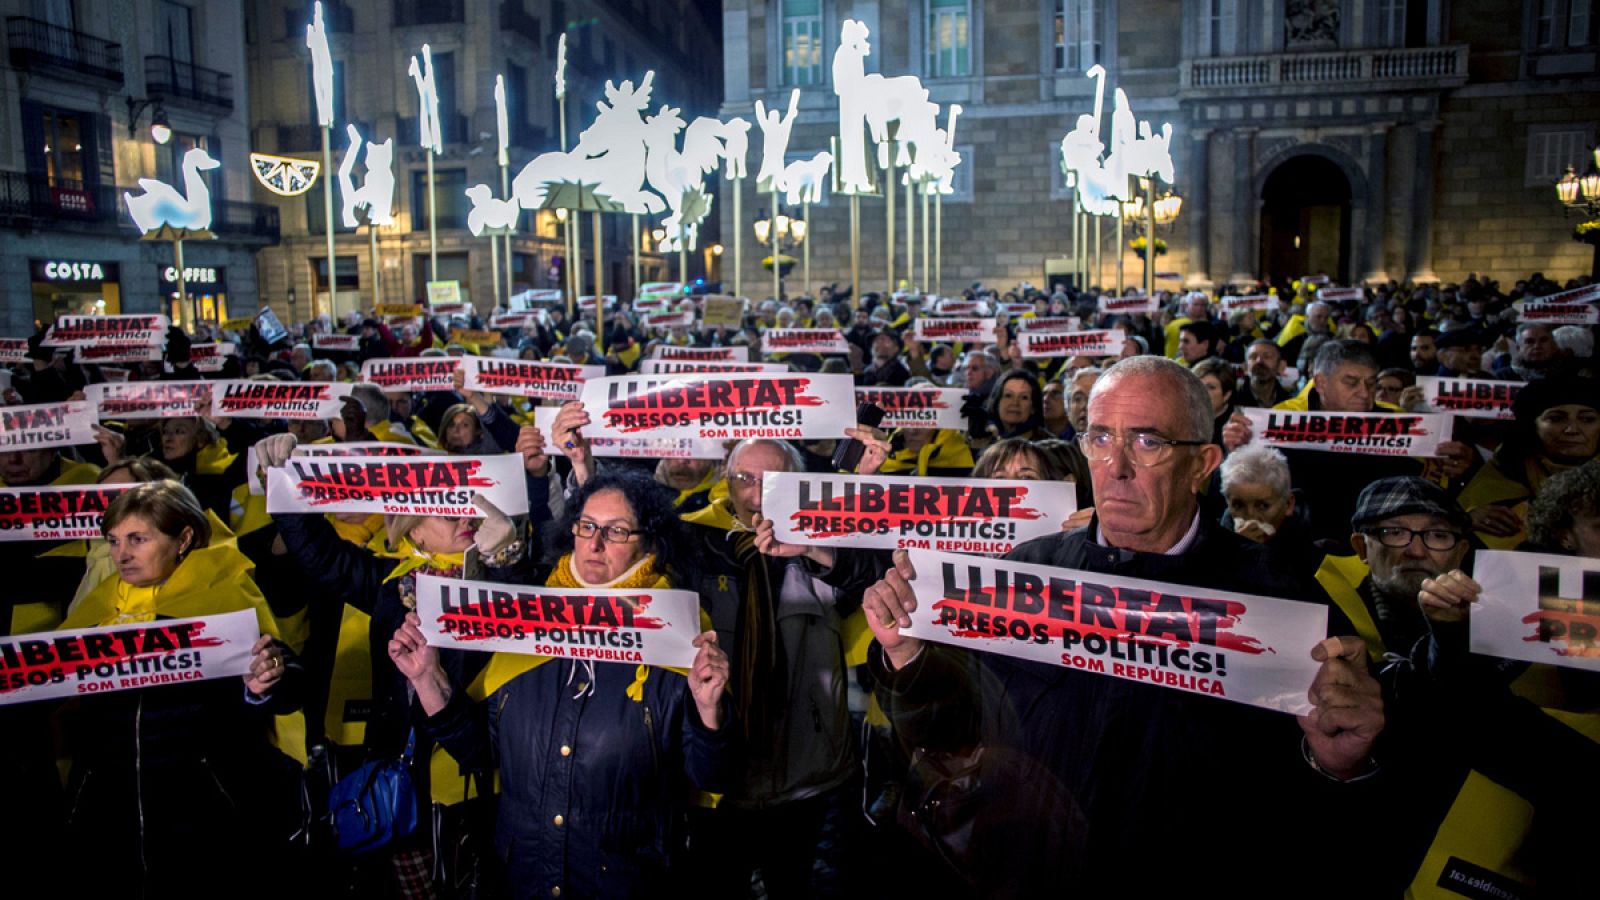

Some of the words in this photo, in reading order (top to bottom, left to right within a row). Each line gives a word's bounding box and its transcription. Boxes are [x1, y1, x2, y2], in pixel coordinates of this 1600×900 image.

[45, 262, 104, 281] COSTA
[53, 317, 153, 332] LLIBERTAT
[1028, 333, 1105, 345] LLIBERTAT
[369, 361, 456, 377] LLIBERTAT
[477, 359, 577, 381] LLIBERTAT
[224, 384, 322, 400] LLIBERTAT
[524, 380, 578, 393] POLÍTICS!
[607, 379, 803, 409] LLIBERTAT
[265, 400, 319, 411] POLÍTICS!
[609, 412, 690, 428] PRESOS
[699, 405, 803, 426] POLÍTICS!
[1268, 414, 1415, 435] LLIBERTAT
[699, 429, 729, 439] SOM
[733, 426, 802, 438] REPÚBLICA
[1266, 431, 1328, 443] PRESOS
[1333, 435, 1413, 448] POLÍTICS!
[292, 460, 473, 489] LLIBERTAT
[301, 485, 375, 502] PRESOS
[799, 480, 1018, 518] LLIBERTAT
[383, 505, 411, 514] SOM
[414, 505, 477, 515] REPÚBLICA
[33, 530, 61, 538] SOM
[800, 514, 889, 534] PRESOS
[899, 516, 1017, 541] POLÍTICS!
[897, 539, 931, 550] SOM
[936, 539, 1013, 553] REPÚBLICA
[439, 583, 642, 629] LLIBERTAT
[941, 562, 1228, 647] LLIBERTAT
[443, 617, 525, 641] PRESOS
[535, 624, 643, 649] POLÍTICS!
[941, 605, 1049, 645] PRESOS
[1062, 633, 1227, 677] POLÍTICS!
[535, 643, 566, 657] SOM
[570, 645, 643, 662] REPÚBLICA
[77, 650, 203, 681] POLÍTICS!
[1061, 652, 1105, 673] SOM
[1112, 662, 1226, 696] REPÚBLICA
[78, 679, 115, 694] SOM
[120, 668, 204, 690] REPÚBLICA
